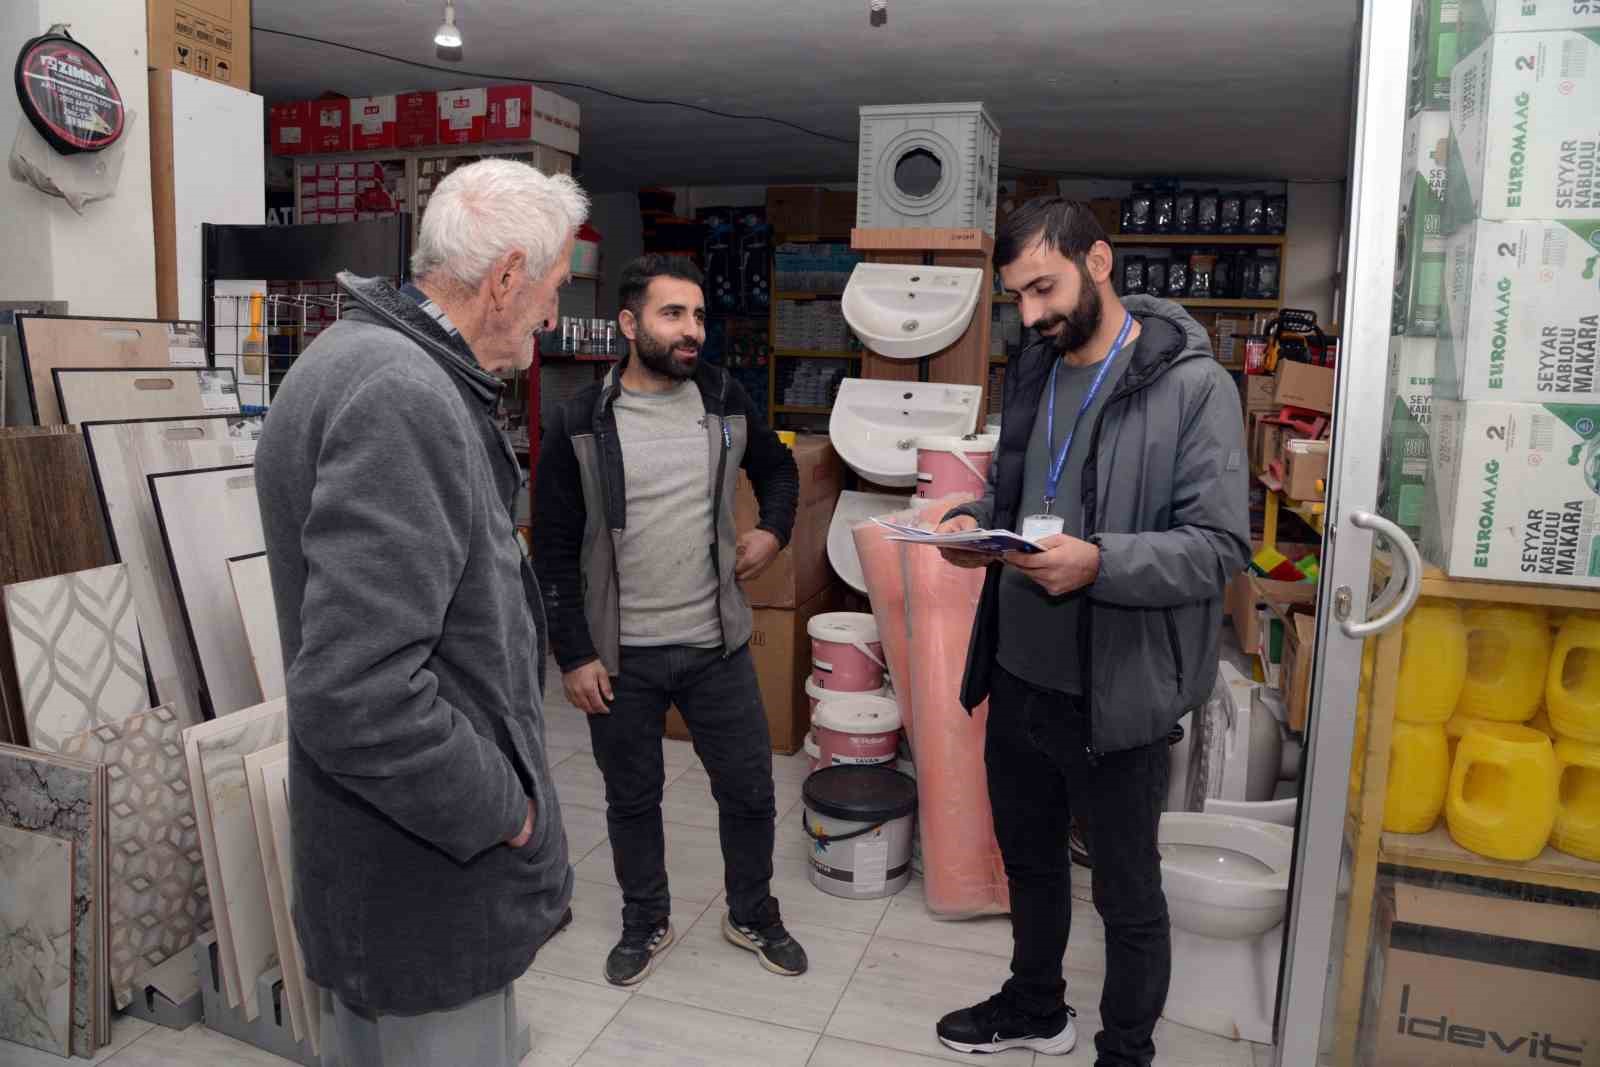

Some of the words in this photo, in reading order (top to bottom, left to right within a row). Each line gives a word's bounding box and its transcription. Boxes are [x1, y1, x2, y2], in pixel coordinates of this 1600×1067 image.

[1515, 55, 1535, 71] 2
[1556, 140, 1577, 209] SEYYAR
[1574, 141, 1596, 209] KABLOLU
[1497, 242, 1518, 257] 2
[1537, 326, 1558, 392] SEYYAR
[1555, 328, 1576, 392] KABLOLU
[1573, 315, 1599, 393] MAKARA
[1486, 426, 1505, 440] 2
[1521, 508, 1544, 573] SEYYAR
[1538, 512, 1561, 574] KABLOLU
[1555, 500, 1584, 576] MAKARA
